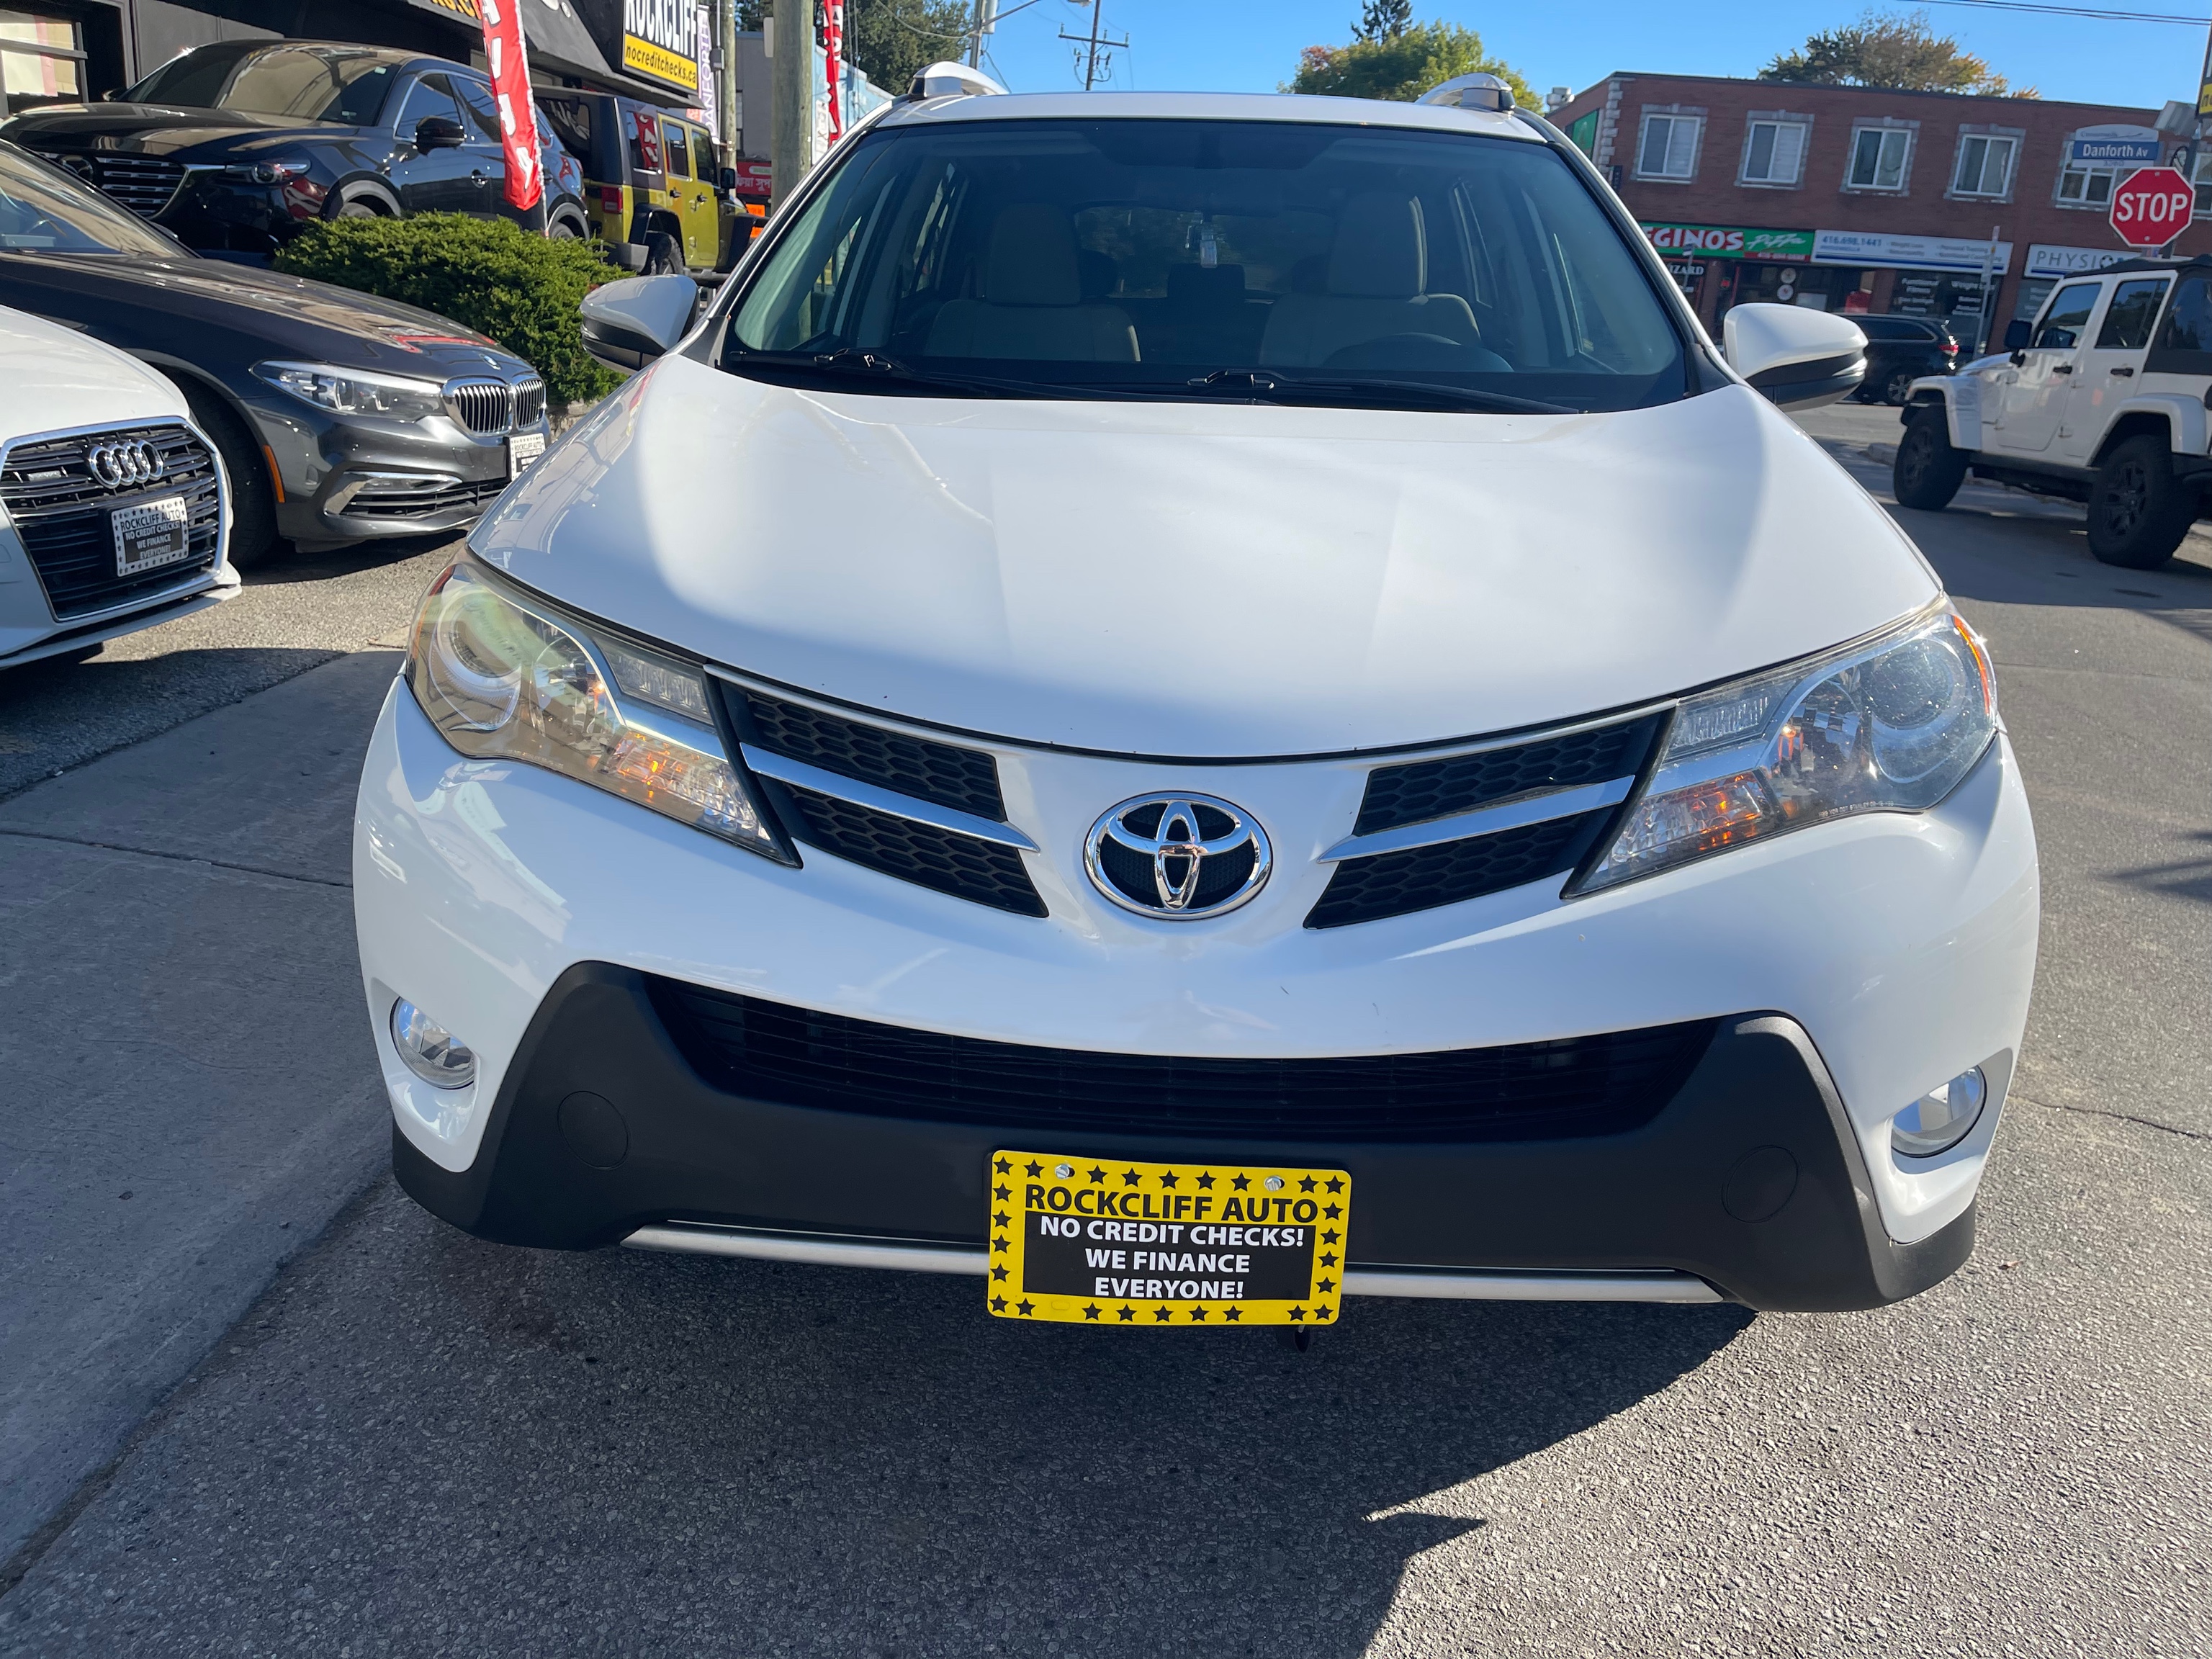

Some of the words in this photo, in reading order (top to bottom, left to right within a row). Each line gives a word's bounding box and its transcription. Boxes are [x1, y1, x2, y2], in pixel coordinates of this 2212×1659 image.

[626, 45, 696, 84] nocreditchecks.ca
[2082, 143, 2134, 158] Danforth
[2136, 147, 2149, 158] Av
[2116, 192, 2188, 222] STOP
[1668, 262, 1704, 276] IZARD
[120, 513, 160, 532] ROCKCLIFF
[161, 509, 181, 521] AUTO
[125, 531, 135, 541] NO
[135, 526, 156, 539] CREDIT
[136, 540, 146, 549] WE
[147, 534, 171, 546] FINANCE
[1025, 1184, 1213, 1220] ROCKCLIFF
[1221, 1197, 1318, 1223] AUTO
[1040, 1215, 1081, 1238] NO
[1087, 1219, 1184, 1244] CREDIT
[1190, 1224, 1305, 1247] CHECKS!
[1085, 1248, 1126, 1270] WE
[1133, 1250, 1251, 1274] FINANCE
[1094, 1277, 1245, 1300] EVERYONE!
